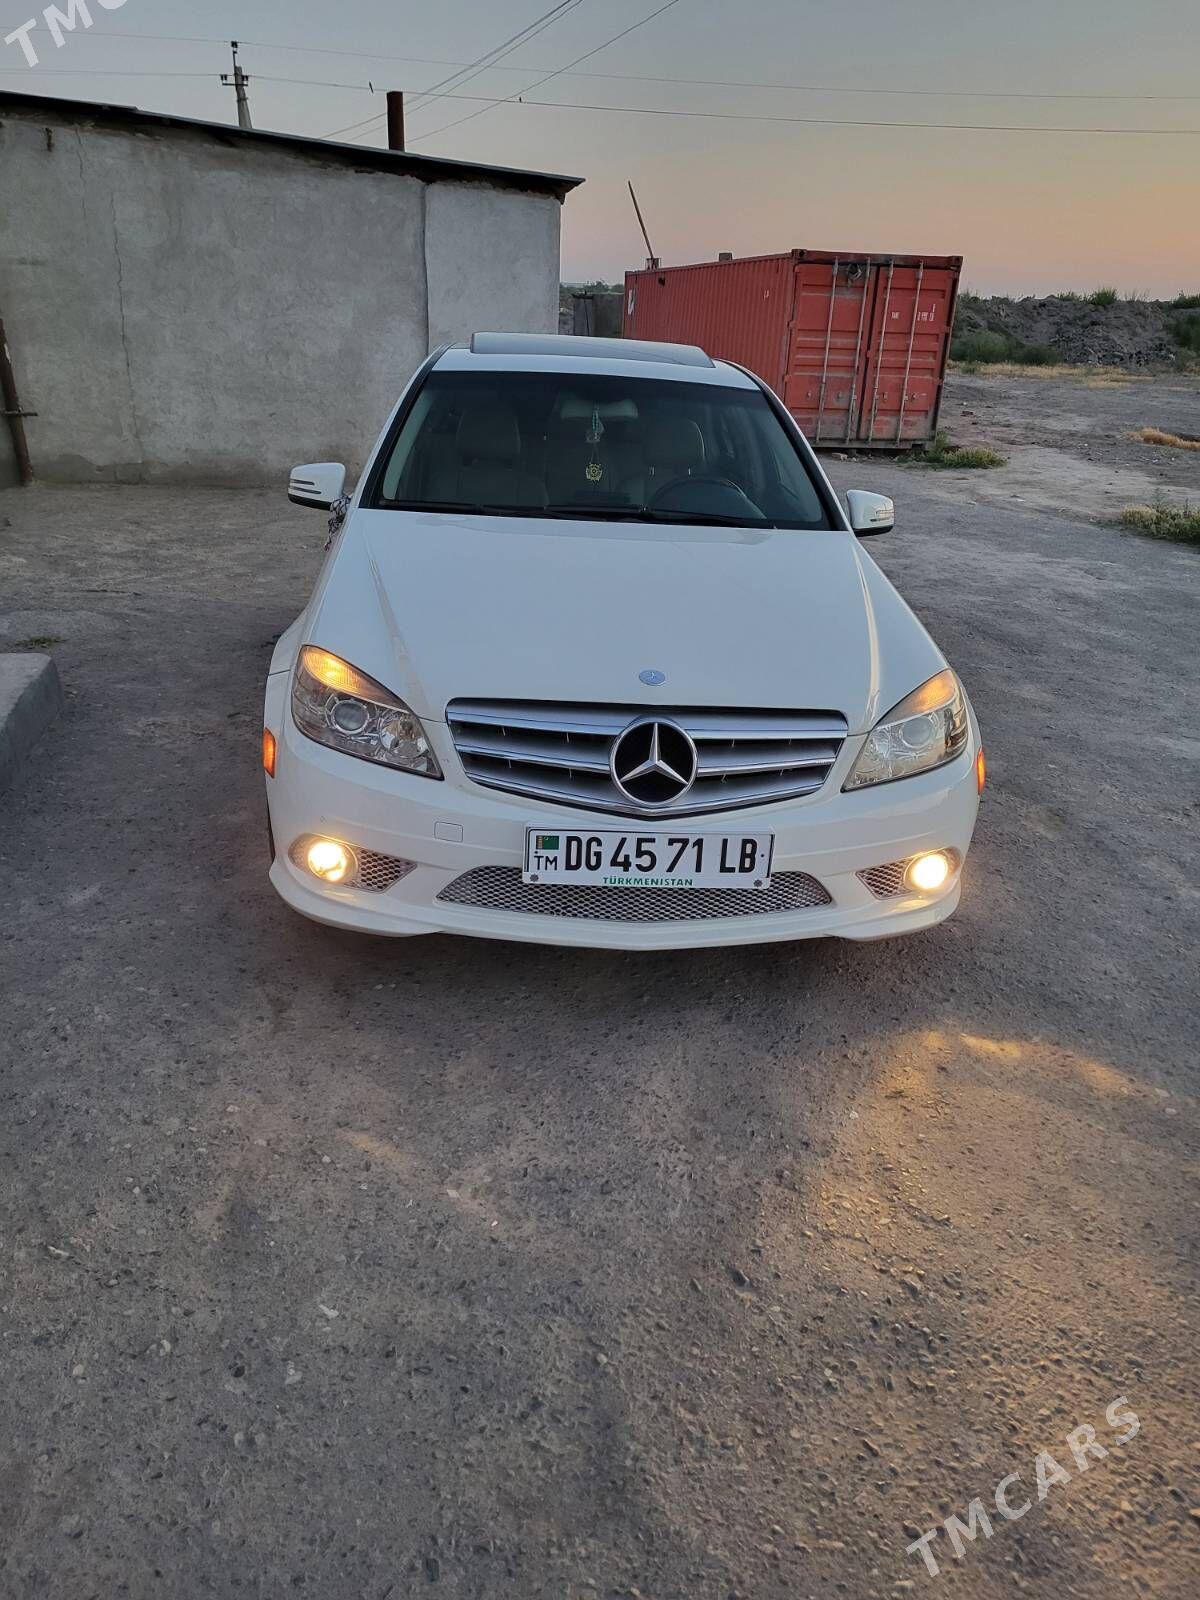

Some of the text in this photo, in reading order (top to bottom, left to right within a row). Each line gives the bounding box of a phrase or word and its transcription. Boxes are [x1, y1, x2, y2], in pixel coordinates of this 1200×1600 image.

[564, 835, 603, 871] DG
[719, 838, 758, 873] LB
[534, 855, 558, 871] TM
[602, 876, 694, 887] TÜRKMENISTAN
